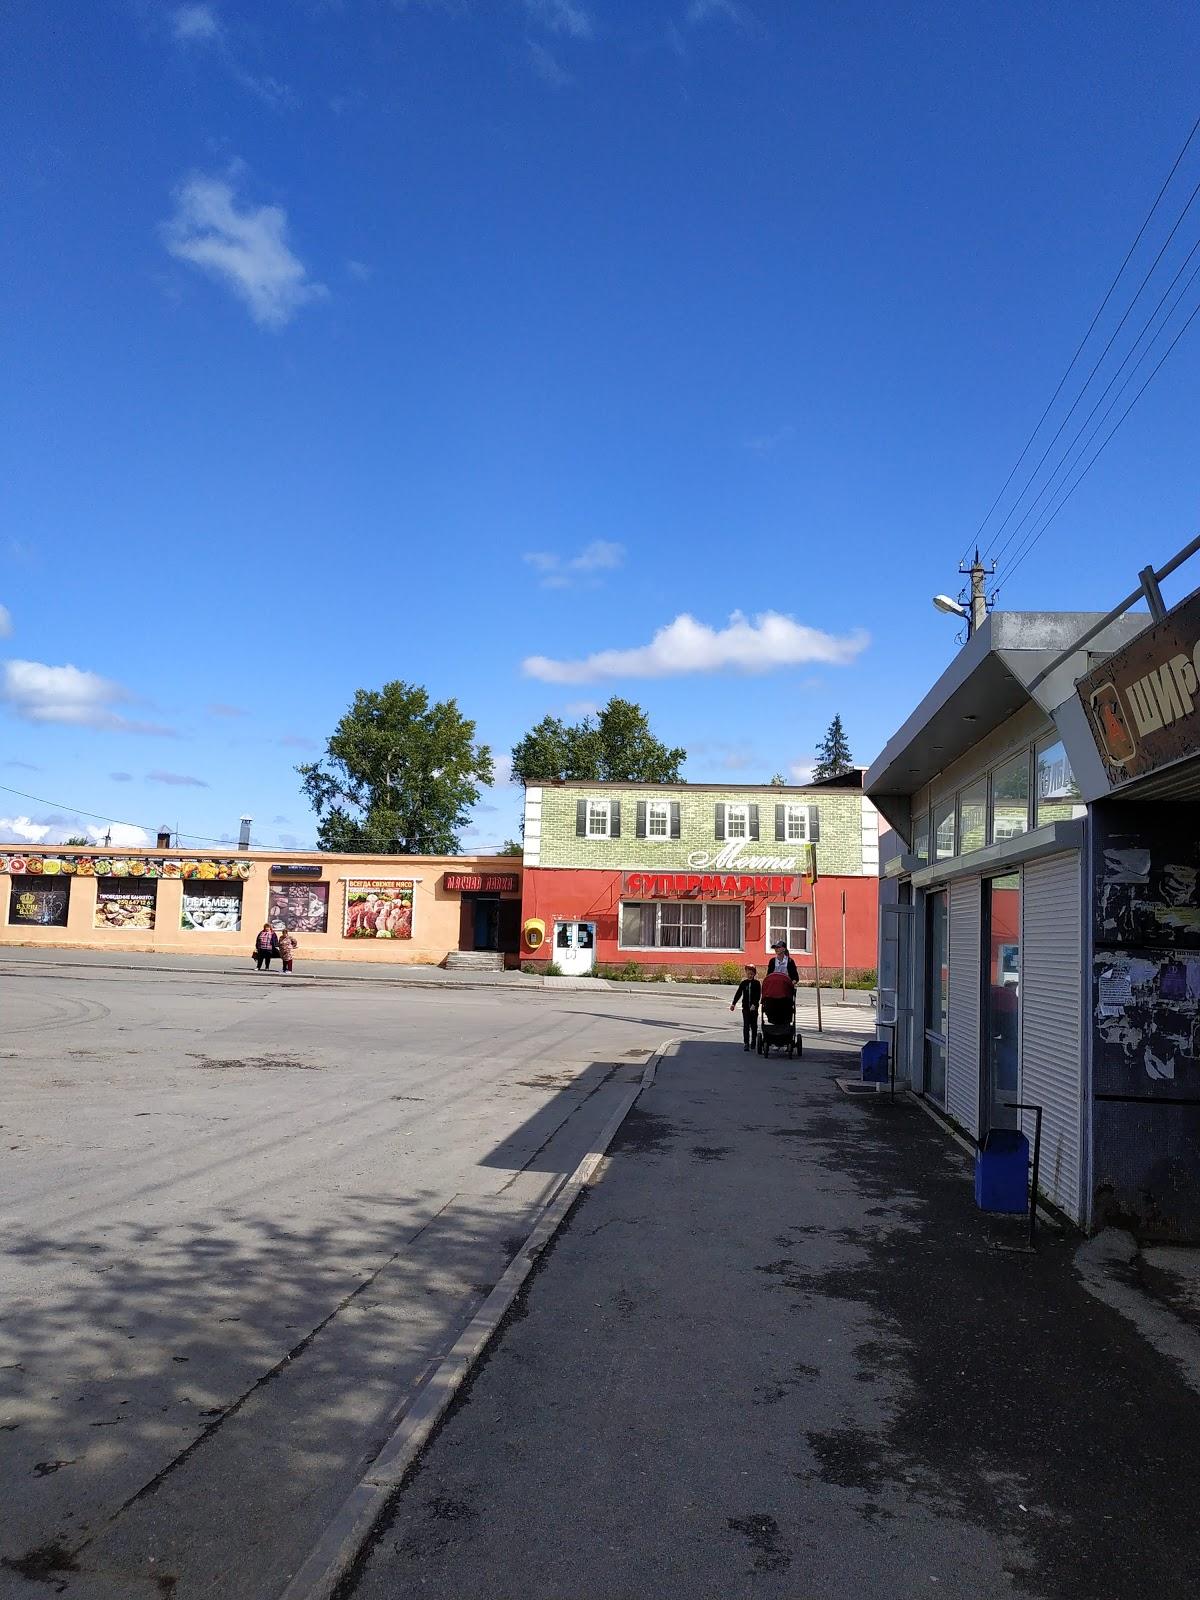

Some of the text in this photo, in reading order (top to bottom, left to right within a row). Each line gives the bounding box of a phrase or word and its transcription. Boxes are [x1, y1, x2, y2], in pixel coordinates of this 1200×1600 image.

[1125, 640, 1200, 736] ШИР
[349, 880, 371, 888] ВСЕГДА
[626, 873, 795, 893] СУПЕРМАРКЕТ
[186, 898, 239, 907] ПЕЛЬМЕНИ
